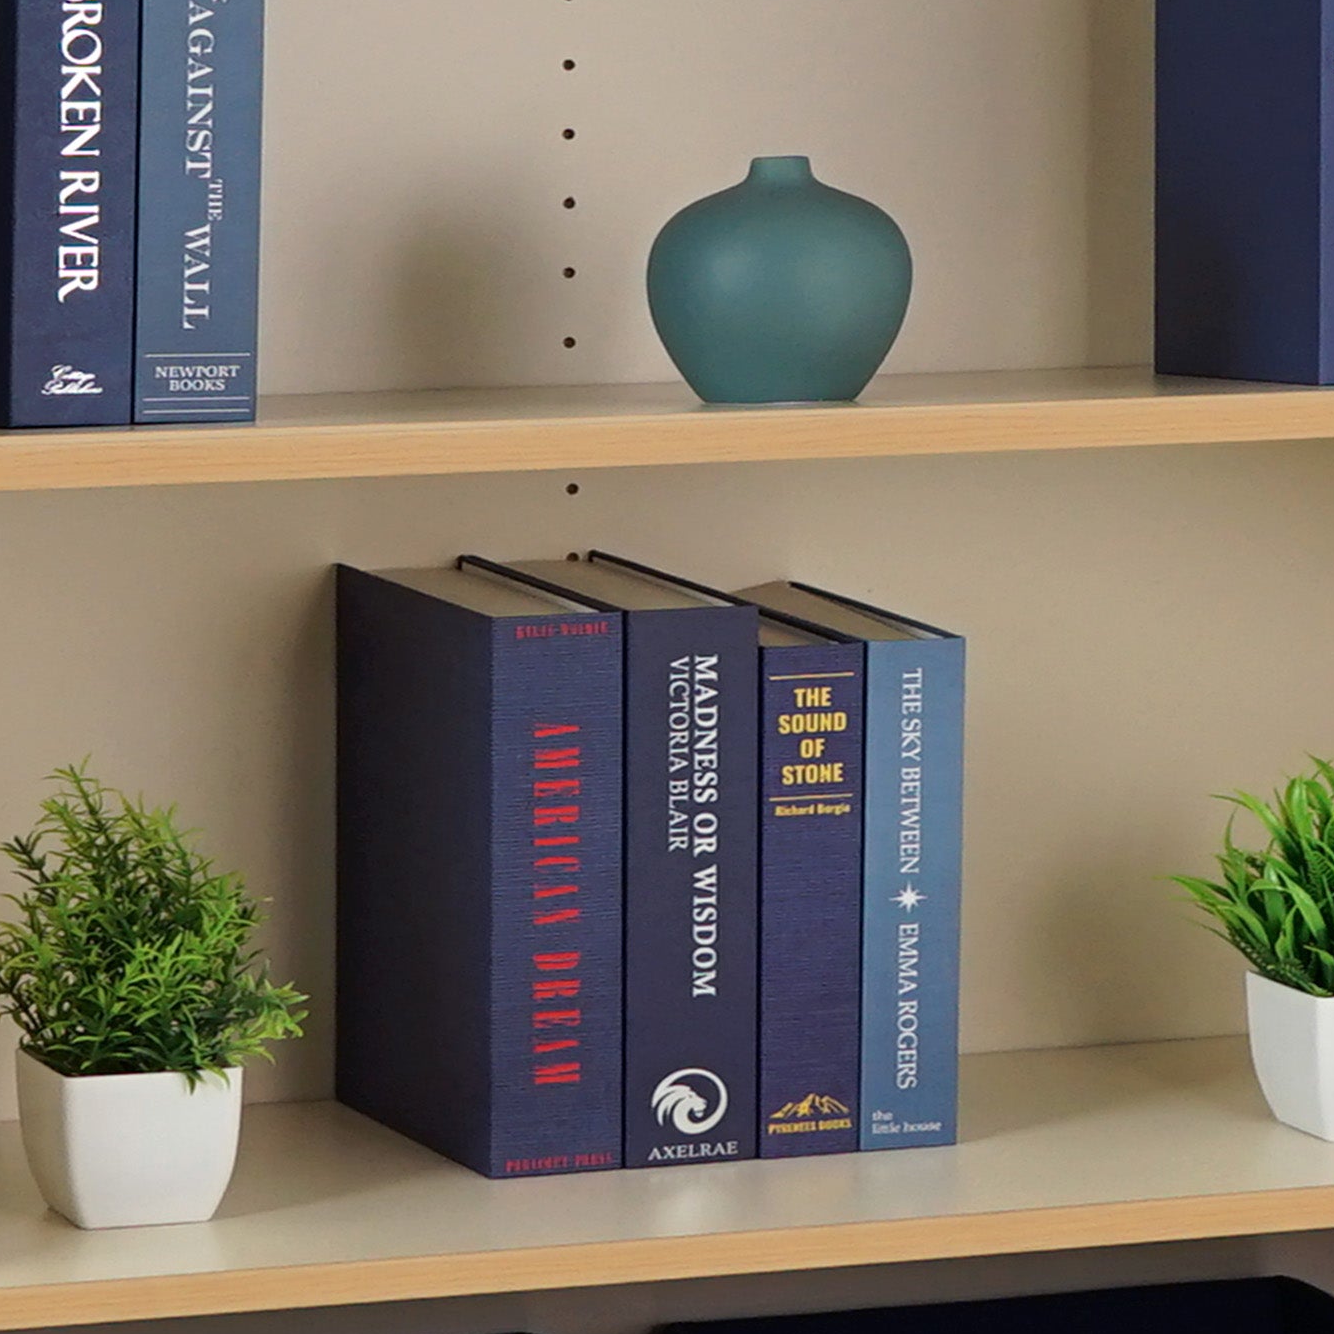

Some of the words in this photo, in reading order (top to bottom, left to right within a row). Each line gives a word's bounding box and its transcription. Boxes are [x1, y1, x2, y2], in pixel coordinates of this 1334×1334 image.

[186, 0, 215, 178] AGAINST
[208, 178, 223, 221] THE
[57, 170, 100, 303] RIVER
[183, 223, 211, 329] WALL
[154, 366, 241, 378] NEWPORT
[169, 380, 225, 391] BOOKS
[794, 687, 831, 707] THE
[901, 668, 922, 713] THE
[669, 657, 690, 775] VICTORIA
[694, 655, 718, 803] MADNESS
[778, 711, 847, 734] SOUND
[901, 718, 922, 761] SKY
[800, 738, 825, 758] OF
[782, 763, 843, 785] STONE
[533, 723, 581, 926] AMERICAN
[669, 780, 689, 852] BLAIR
[693, 810, 718, 857] OR
[775, 805, 815, 817] Richard
[900, 766, 921, 874] BETWEEN
[692, 864, 718, 997] WISDOM
[898, 923, 919, 994] EMMA
[532, 951, 581, 1085] DREAM
[897, 1000, 918, 1089] ROGERS
[903, 1121, 942, 1132] house
[648, 1141, 738, 1161] AXELRAE
